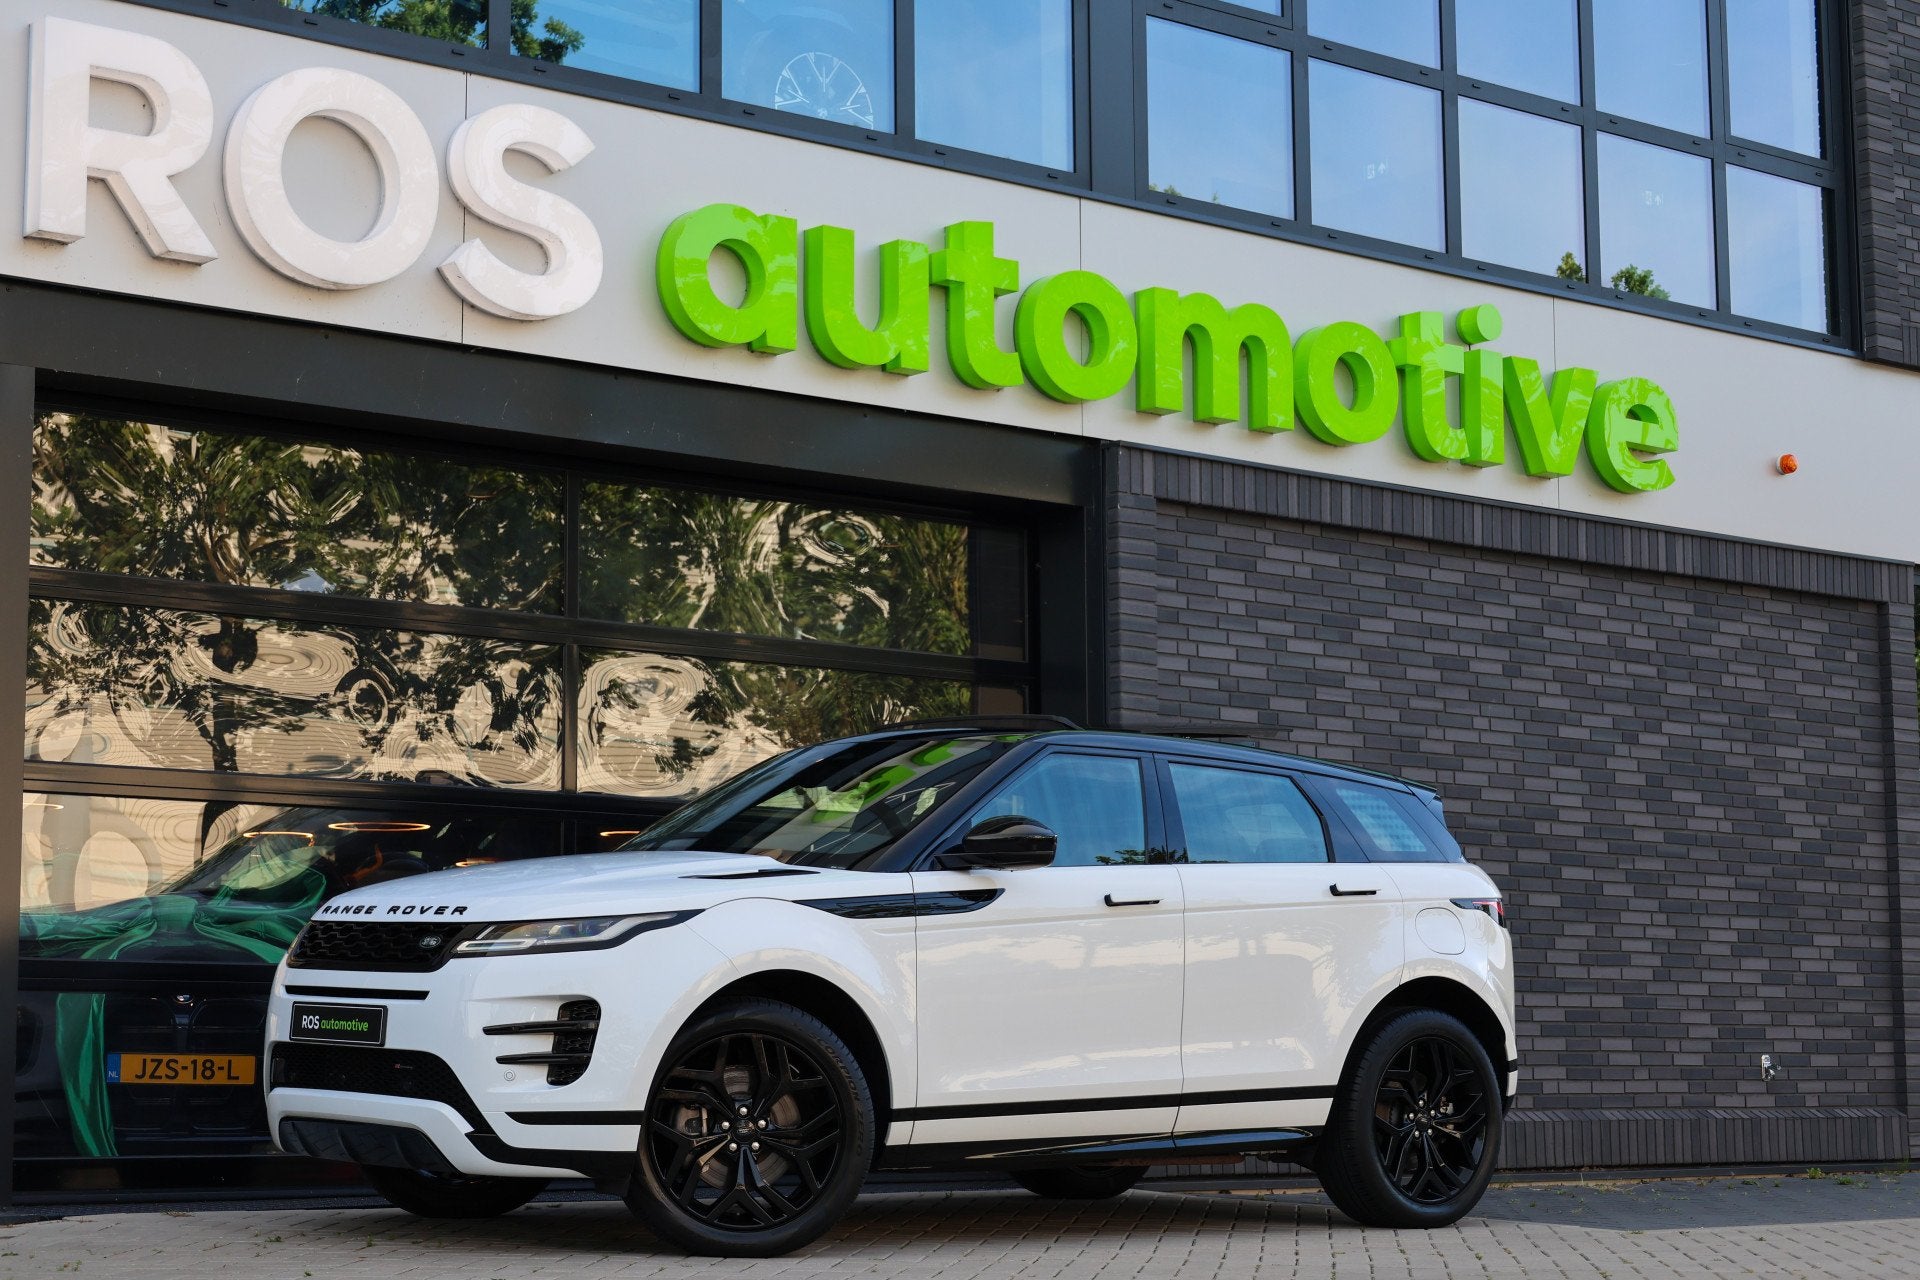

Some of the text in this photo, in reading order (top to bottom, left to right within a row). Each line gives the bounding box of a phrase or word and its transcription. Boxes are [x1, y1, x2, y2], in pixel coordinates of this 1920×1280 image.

[23, 15, 1679, 494] ROS automotive
[321, 905, 468, 916] RANGE ROVER
[301, 1014, 369, 1032] ROS automotive
[108, 1058, 239, 1080] NL JZS-18-L
